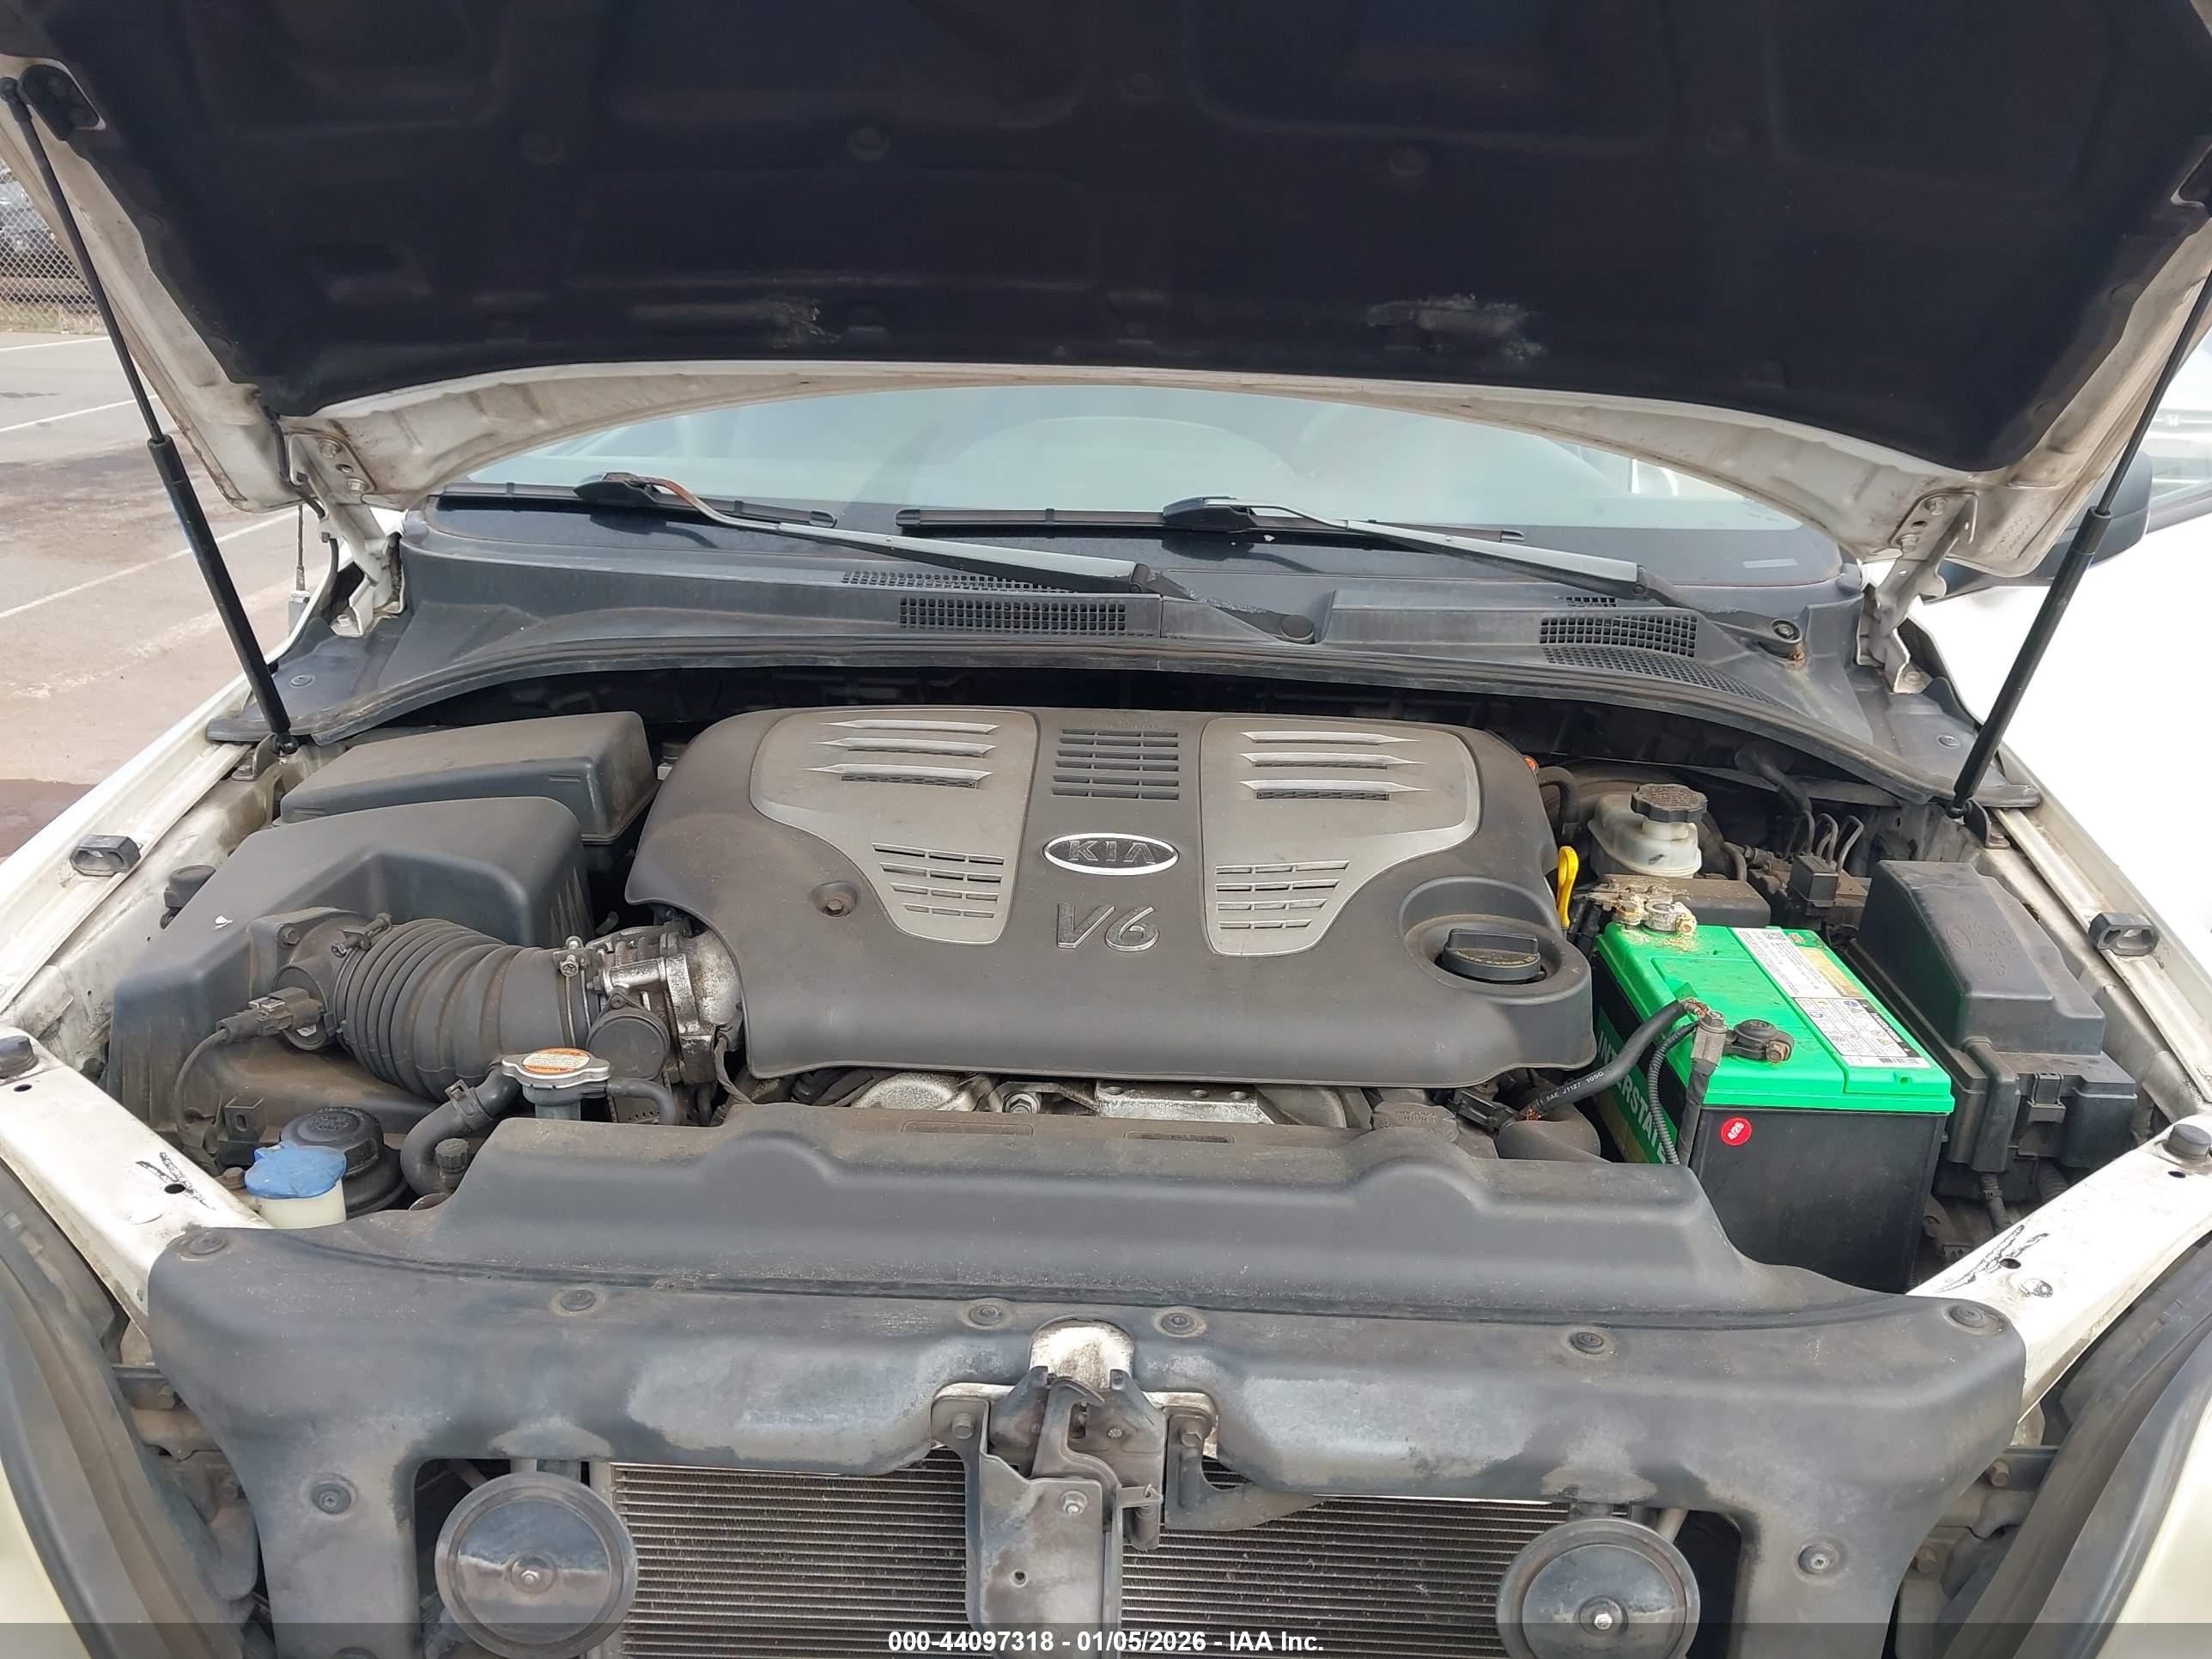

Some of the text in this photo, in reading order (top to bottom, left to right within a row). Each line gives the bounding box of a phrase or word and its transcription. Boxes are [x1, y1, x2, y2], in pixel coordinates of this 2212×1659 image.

[1067, 840, 1158, 864] KIA
[1056, 901, 1160, 952] V6
[1546, 1091, 1559, 1102] SAE
[1562, 1082, 1581, 1095] J1127
[1598, 1030, 1667, 1164] INTRSTATE
